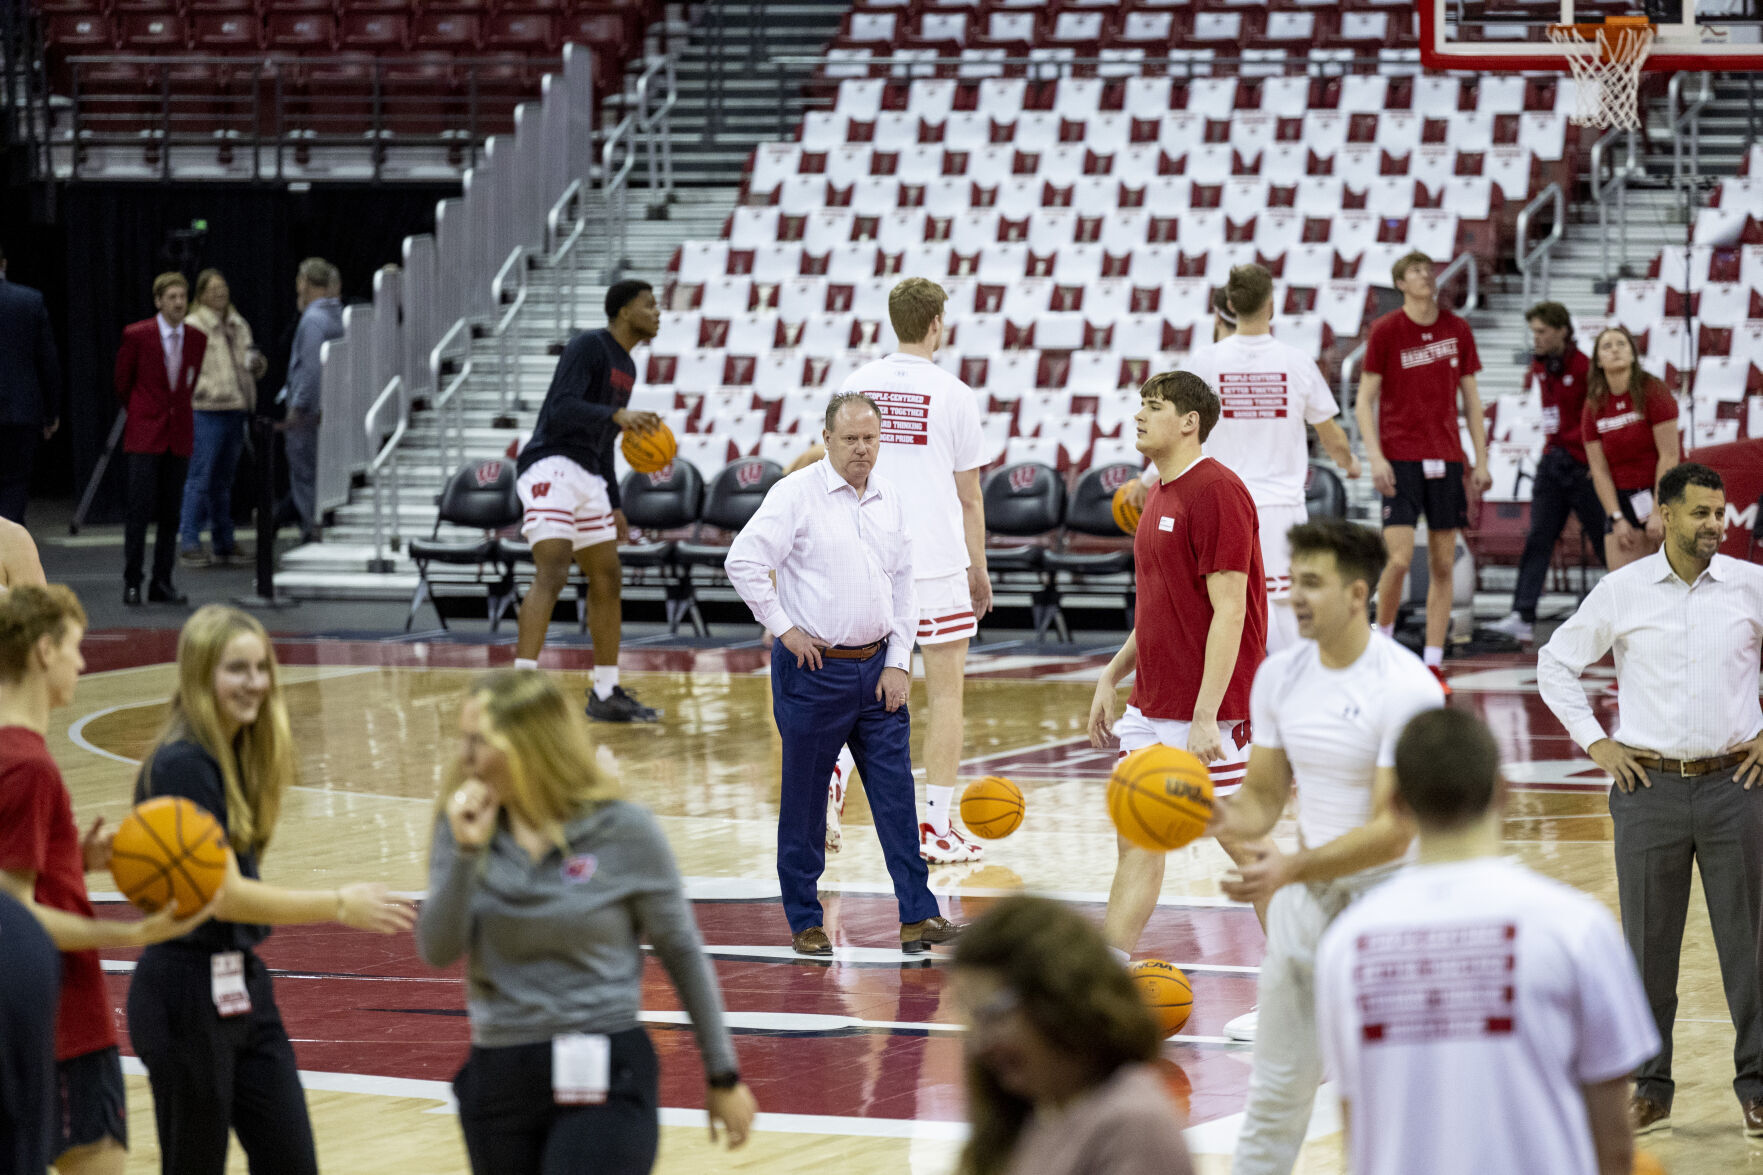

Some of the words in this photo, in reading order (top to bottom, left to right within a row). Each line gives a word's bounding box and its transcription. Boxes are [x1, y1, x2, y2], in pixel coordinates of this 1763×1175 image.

[889, 407, 924, 417] TOGETHER
[893, 421, 923, 430] THINKING
[895, 434, 914, 443] PRIDE
